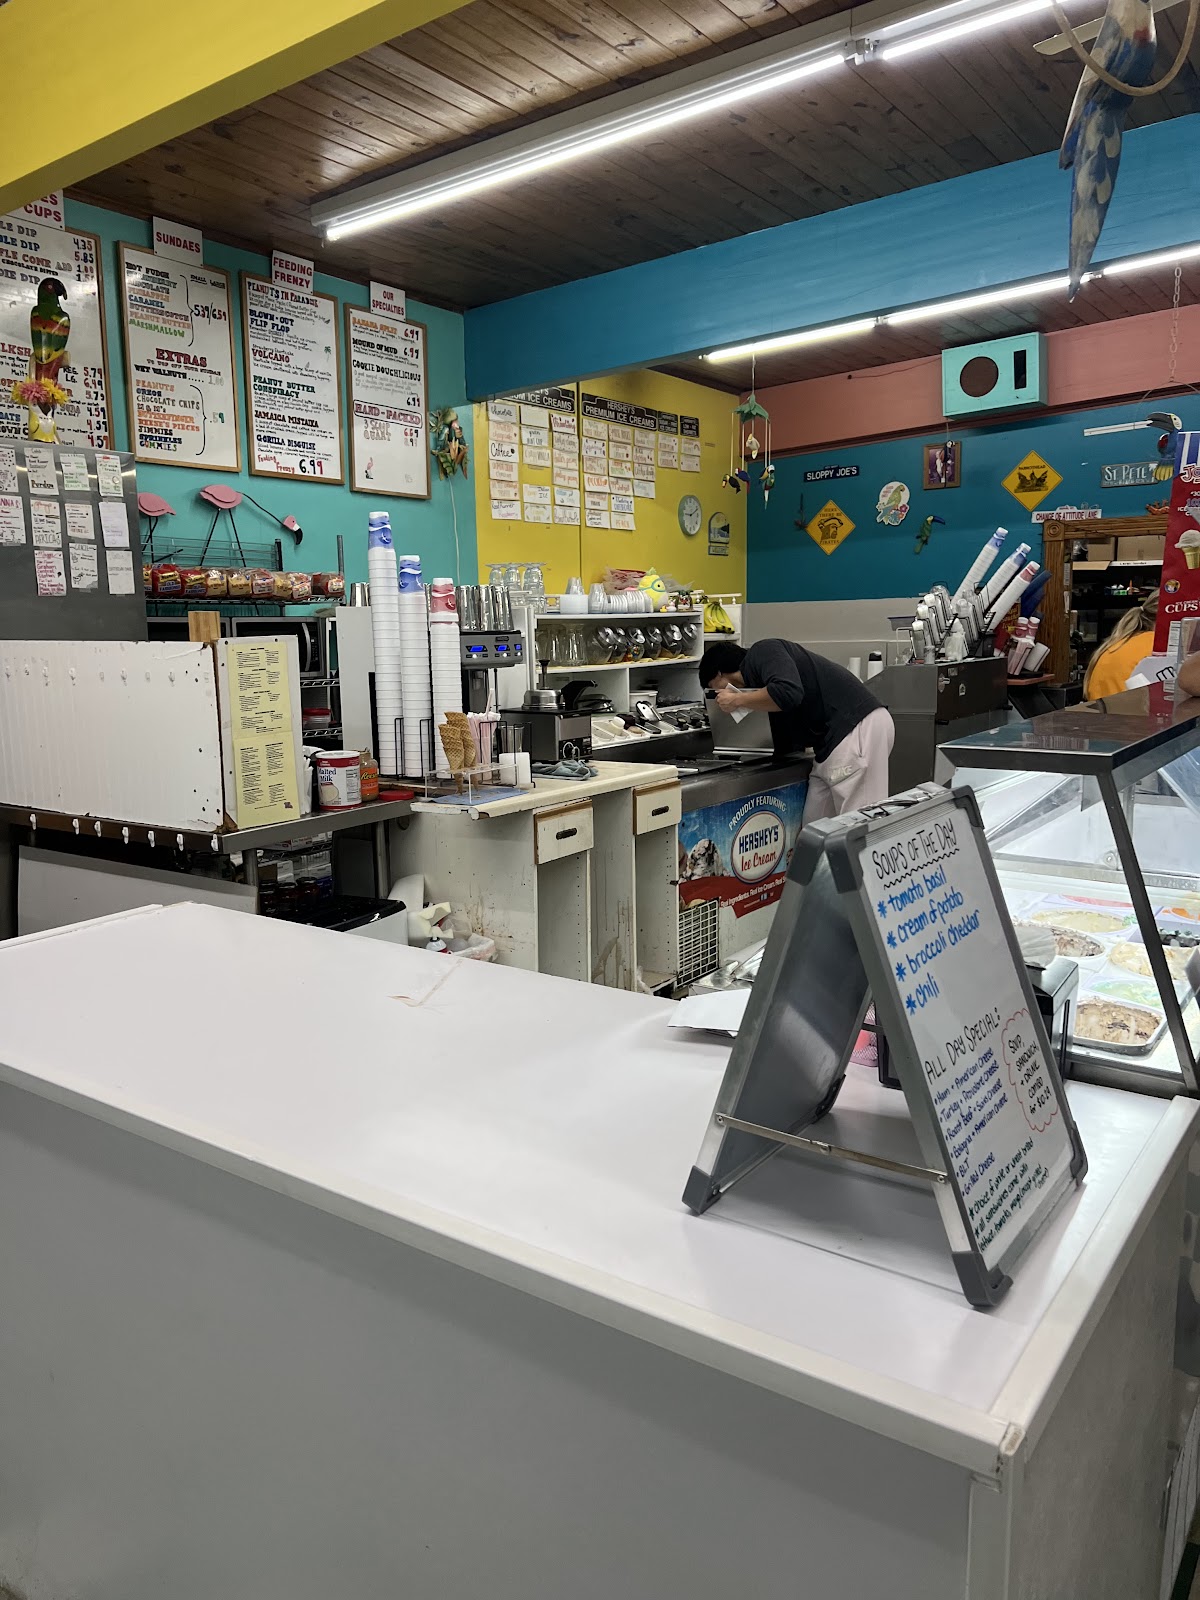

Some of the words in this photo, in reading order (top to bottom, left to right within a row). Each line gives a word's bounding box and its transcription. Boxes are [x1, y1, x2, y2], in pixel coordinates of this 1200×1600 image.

[24, 203, 62, 222] CUPS
[17, 225, 37, 237] DIP
[21, 240, 40, 251] DIP
[156, 232, 200, 253] SUNDAES
[22, 254, 51, 268] CONE
[273, 257, 312, 276] FEEDING
[126, 262, 142, 271] HOT
[146, 267, 169, 279] FUDGE
[20, 273, 40, 285] DIP
[275, 271, 310, 289] FRENZY
[248, 281, 280, 299] PEANUTS
[281, 290, 289, 301] IN
[383, 291, 393, 301] OUR
[129, 295, 165, 308] CARAMEL
[372, 299, 404, 315] SPECIALTIES
[129, 319, 184, 337] MARSHMALLOW
[250, 317, 268, 328] FLIP
[271, 322, 290, 333] FLOP
[404, 328, 419, 341] 6.99
[252, 348, 290, 363] VOLCANO
[352, 338, 375, 349] MOUND
[384, 346, 397, 354] MUD
[404, 347, 419, 359] 6.99
[156, 348, 207, 367] EXTRAS
[353, 359, 375, 371] COOKIE
[84, 367, 102, 379] 5.79
[134, 364, 150, 373] WET
[84, 378, 103, 390] 6.49
[136, 379, 174, 392] PEANUTS
[253, 375, 282, 387] PEANUT
[287, 381, 315, 393] BUTTER
[253, 384, 299, 398] CONSPIRACY
[136, 388, 162, 397] OREOS
[137, 396, 175, 406] CHOCOLATE
[179, 400, 200, 410] CHIPS
[528, 392, 540, 404] ICE
[543, 396, 572, 411] CREAMS
[607, 400, 635, 414] HERSHEY'S
[87, 407, 106, 419] 4.59
[137, 410, 194, 423] BUTTERFINGER
[255, 410, 286, 422] JAMAICA
[585, 405, 615, 419] PREMIUM
[617, 414, 628, 422] ICE
[629, 416, 654, 428] CREAMS
[138, 425, 173, 436] JIMMIES
[172, 422, 200, 432] PIECES
[88, 435, 108, 449] 4.59
[139, 434, 182, 444] SPRINKLES
[257, 434, 285, 445] GORILLA
[288, 439, 316, 450] DISGUISE
[491, 443, 512, 457] Coffee
[299, 459, 323, 475] 6.99
[807, 469, 834, 481] SLOPPY
[837, 466, 857, 477] JOE'S
[1122, 464, 1147, 480] PETE
[1036, 512, 1054, 521] CHANGE
[1062, 511, 1084, 520] ATTITUDE
[1165, 602, 1198, 613] CUPS
[728, 799, 755, 831] PROUDLY
[756, 796, 787, 812] FEATURING
[739, 825, 779, 855] HERSHEY'S
[872, 842, 908, 880] SOUPS
[907, 838, 919, 861] OF
[916, 829, 938, 858] THE
[934, 818, 957, 851] DAY
[741, 856, 751, 872] Ice
[753, 851, 777, 868] Cream
[888, 879, 924, 911] tomato
[922, 864, 947, 894] basil
[897, 911, 929, 943] cream
[929, 898, 938, 924] of
[937, 886, 964, 925] potato
[905, 930, 947, 974] broccoli
[947, 909, 980, 946] cheddar
[915, 972, 940, 1008] chili
[925, 1056, 947, 1085] ALL
[945, 1035, 967, 1066] DAY
[963, 1006, 1001, 1052] SPECIAL:
[936, 1088, 951, 1105] Ham
[954, 1063, 980, 1090] American
[978, 1047, 994, 1068] Cheese
[940, 1100, 962, 1122] Turkey
[983, 1059, 1000, 1082] Cheese
[947, 1121, 963, 1140] Roast
[987, 1077, 1003, 1100] Cheese
[953, 1134, 973, 1159] Bologna
[974, 1109, 995, 1135] American
[994, 1092, 1008, 1114] Cheese
[959, 1157, 970, 1178] BLT
[964, 1170, 979, 1195] Grilled
[978, 1152, 995, 1176] Cheese
